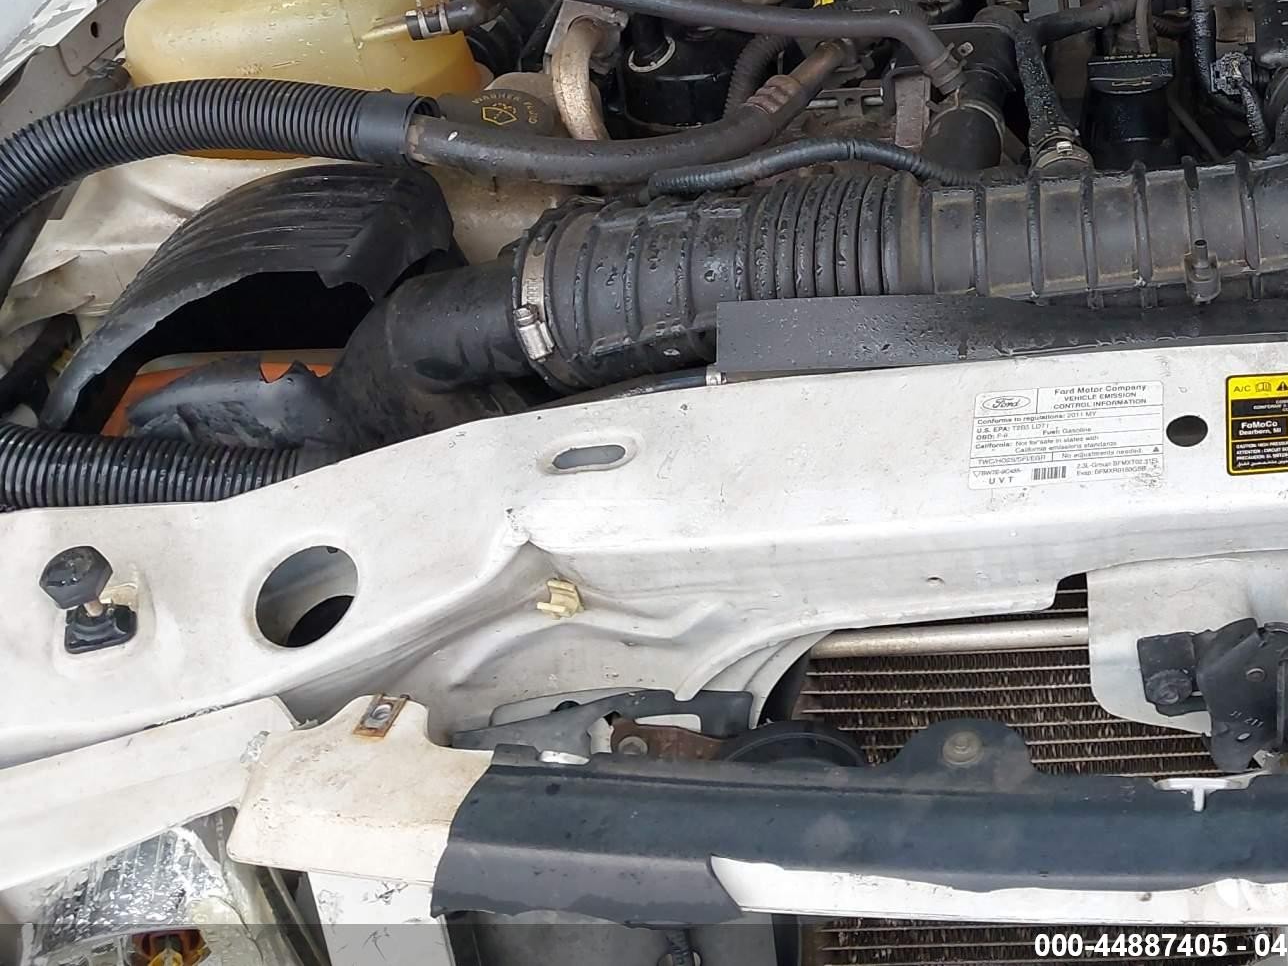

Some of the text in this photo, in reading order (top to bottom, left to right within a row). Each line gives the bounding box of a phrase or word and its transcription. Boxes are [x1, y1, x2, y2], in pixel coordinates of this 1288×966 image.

[1054, 384, 1146, 395] Ford Motor Company
[1233, 384, 1251, 393] A/C
[1064, 391, 1137, 402] VEHICLE EMISSION
[992, 397, 1021, 409] Ford
[1053, 398, 1147, 410] CONTROL INFORMATION
[1241, 420, 1278, 429] FoMoCo
[1238, 428, 1272, 436] Dearborn,
